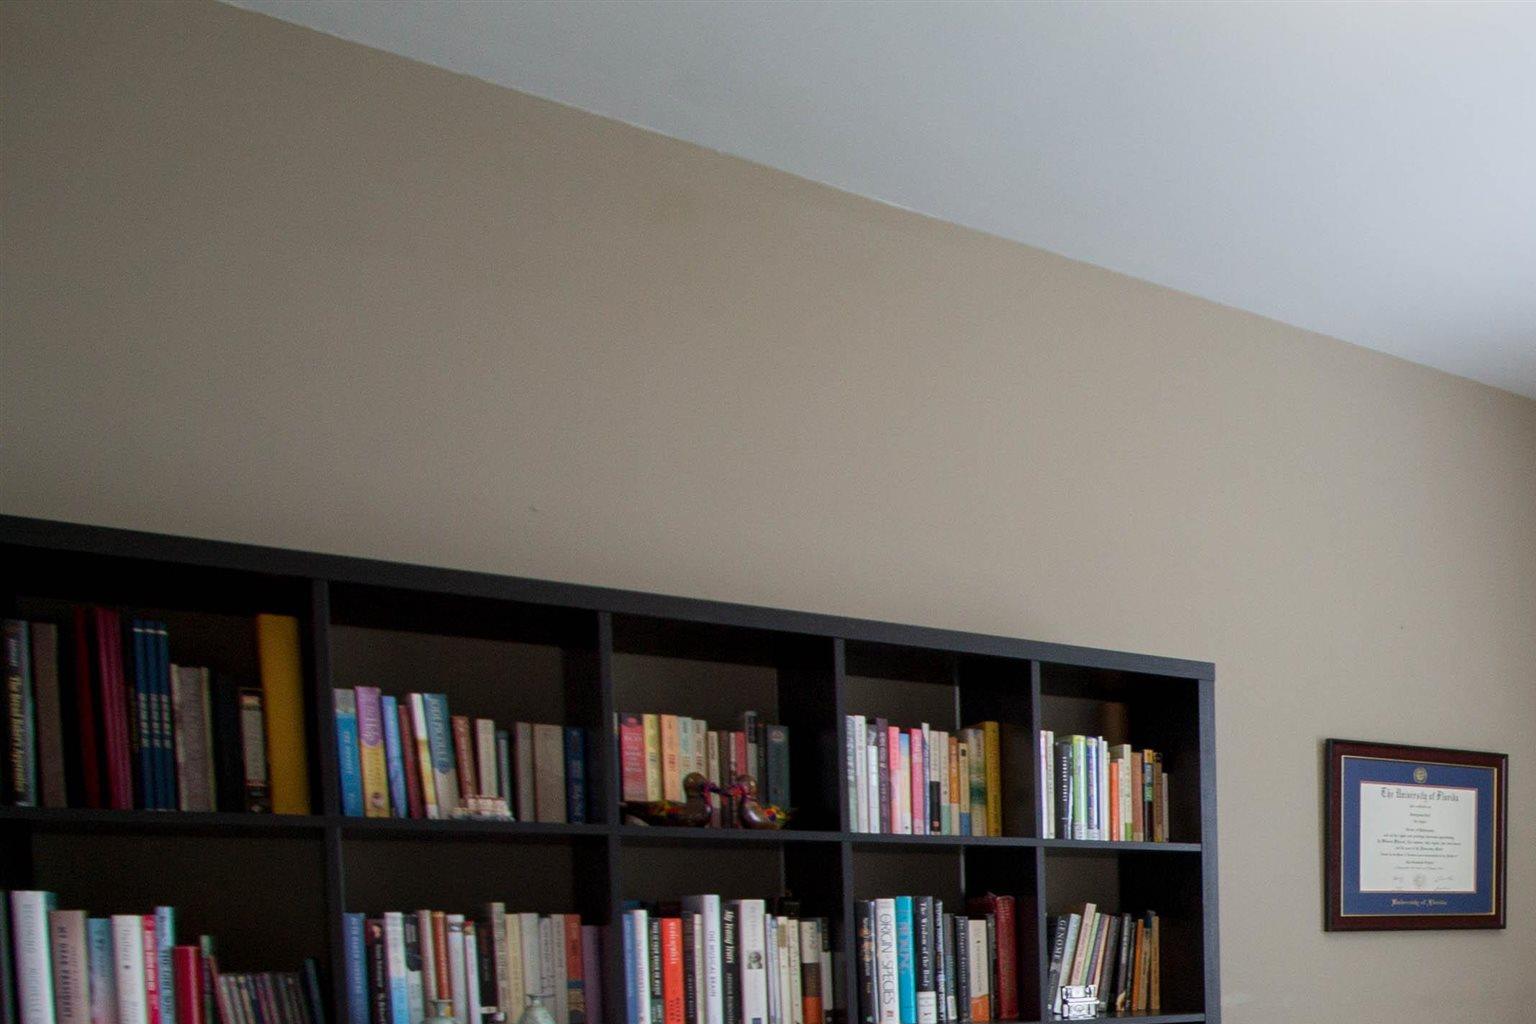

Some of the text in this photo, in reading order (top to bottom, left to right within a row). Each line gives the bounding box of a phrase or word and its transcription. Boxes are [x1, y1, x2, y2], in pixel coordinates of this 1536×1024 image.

[919, 902, 927, 914] The
[919, 918, 928, 944] Wisdom
[879, 912, 895, 1005] ORIGIN SPECIES
